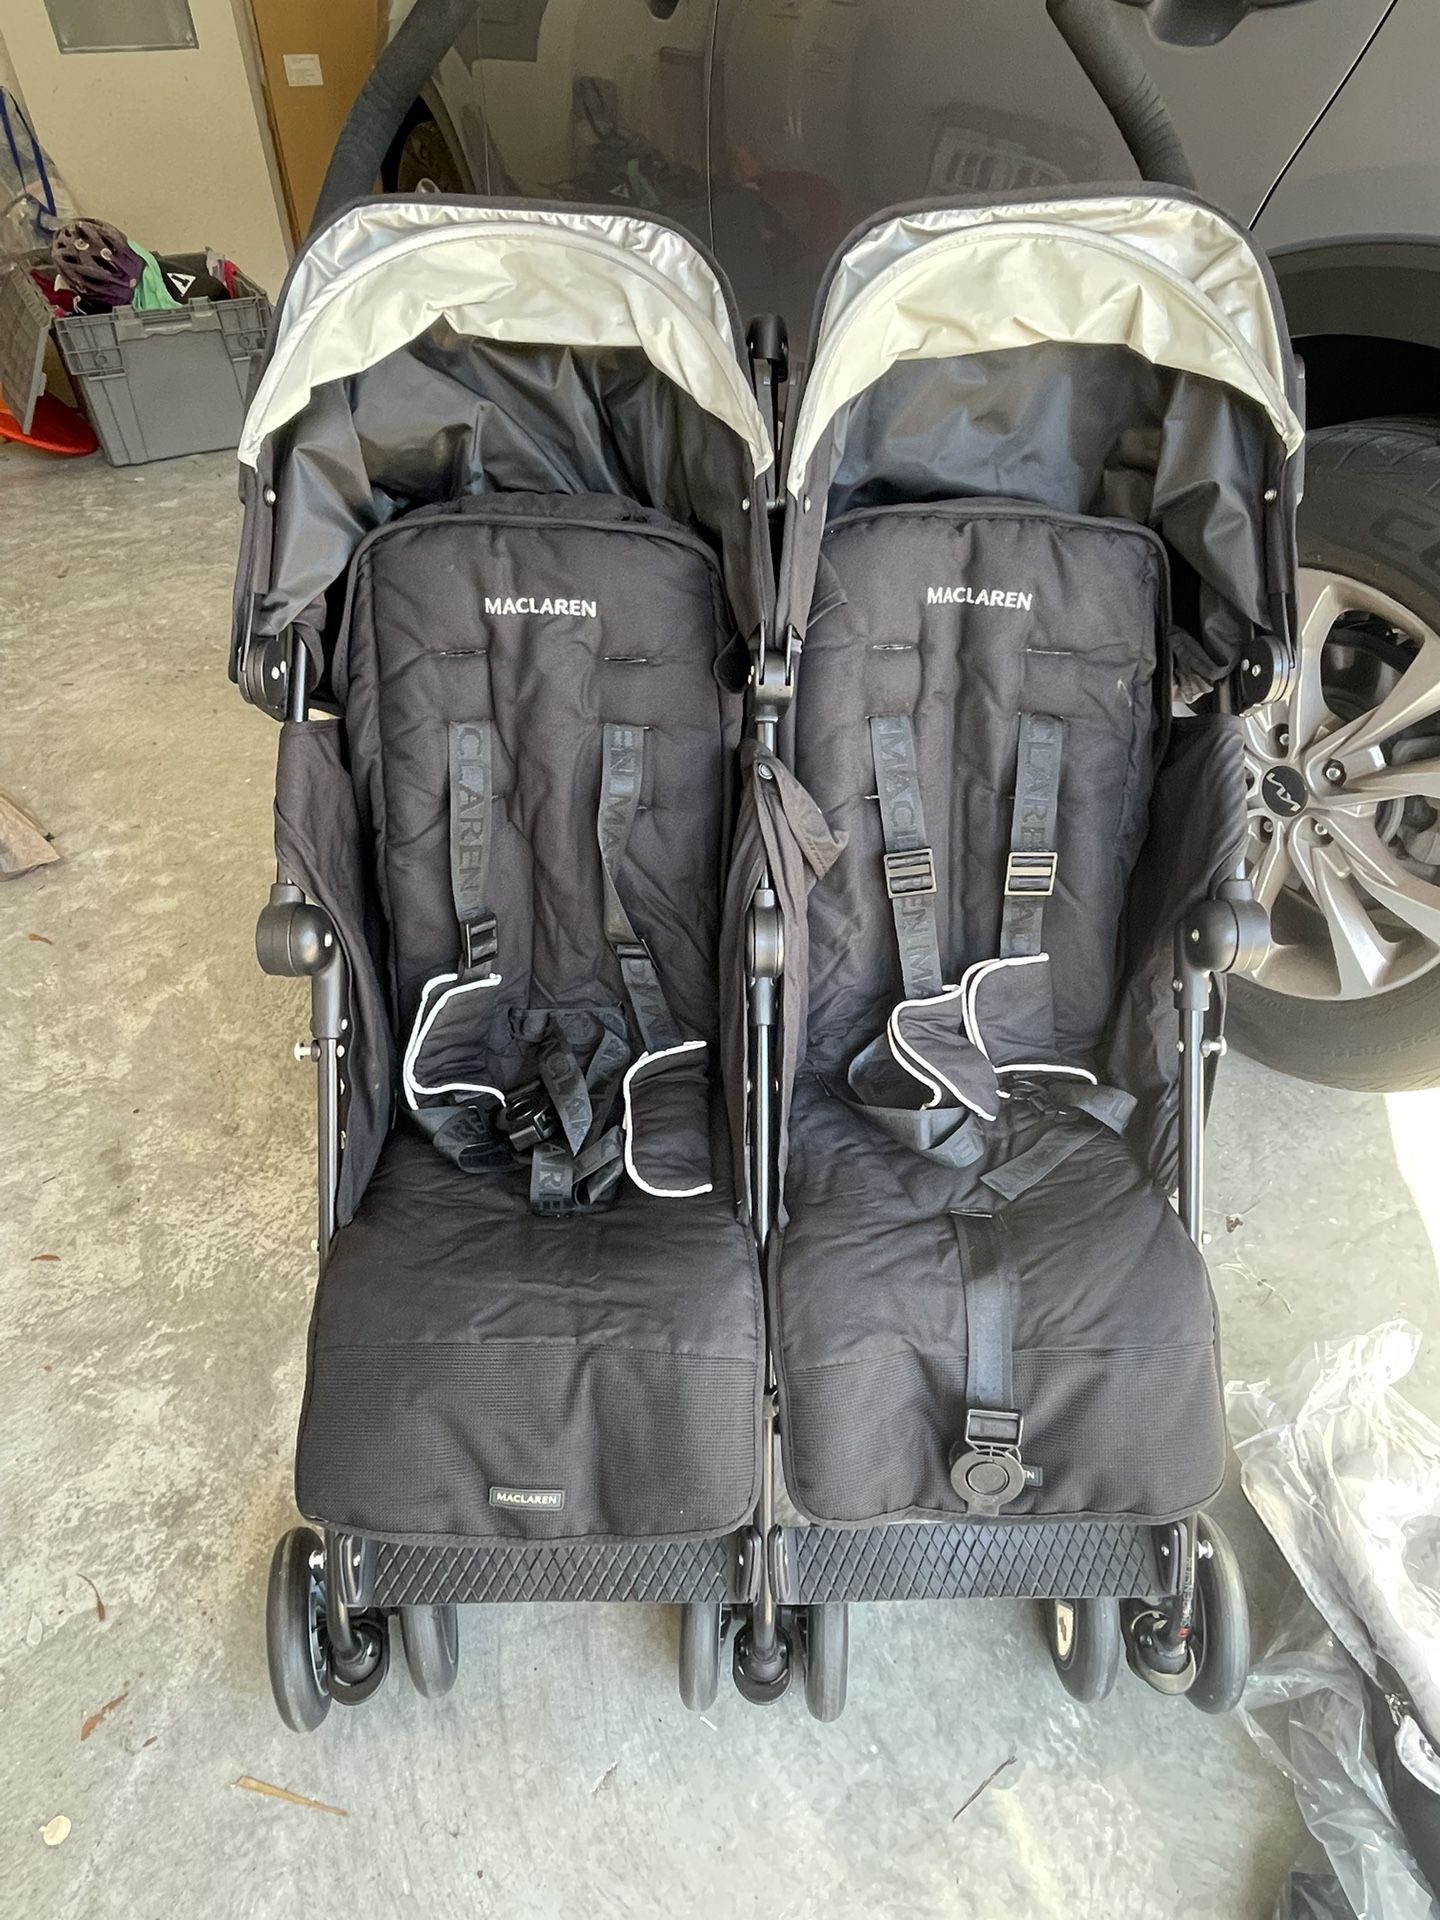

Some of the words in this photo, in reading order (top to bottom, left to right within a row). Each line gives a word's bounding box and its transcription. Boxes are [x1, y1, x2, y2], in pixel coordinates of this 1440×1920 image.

[484, 597, 597, 618] MACLAREN
[927, 586, 1033, 611] MACLAREN
[496, 1492, 557, 1504] MACLAREN
